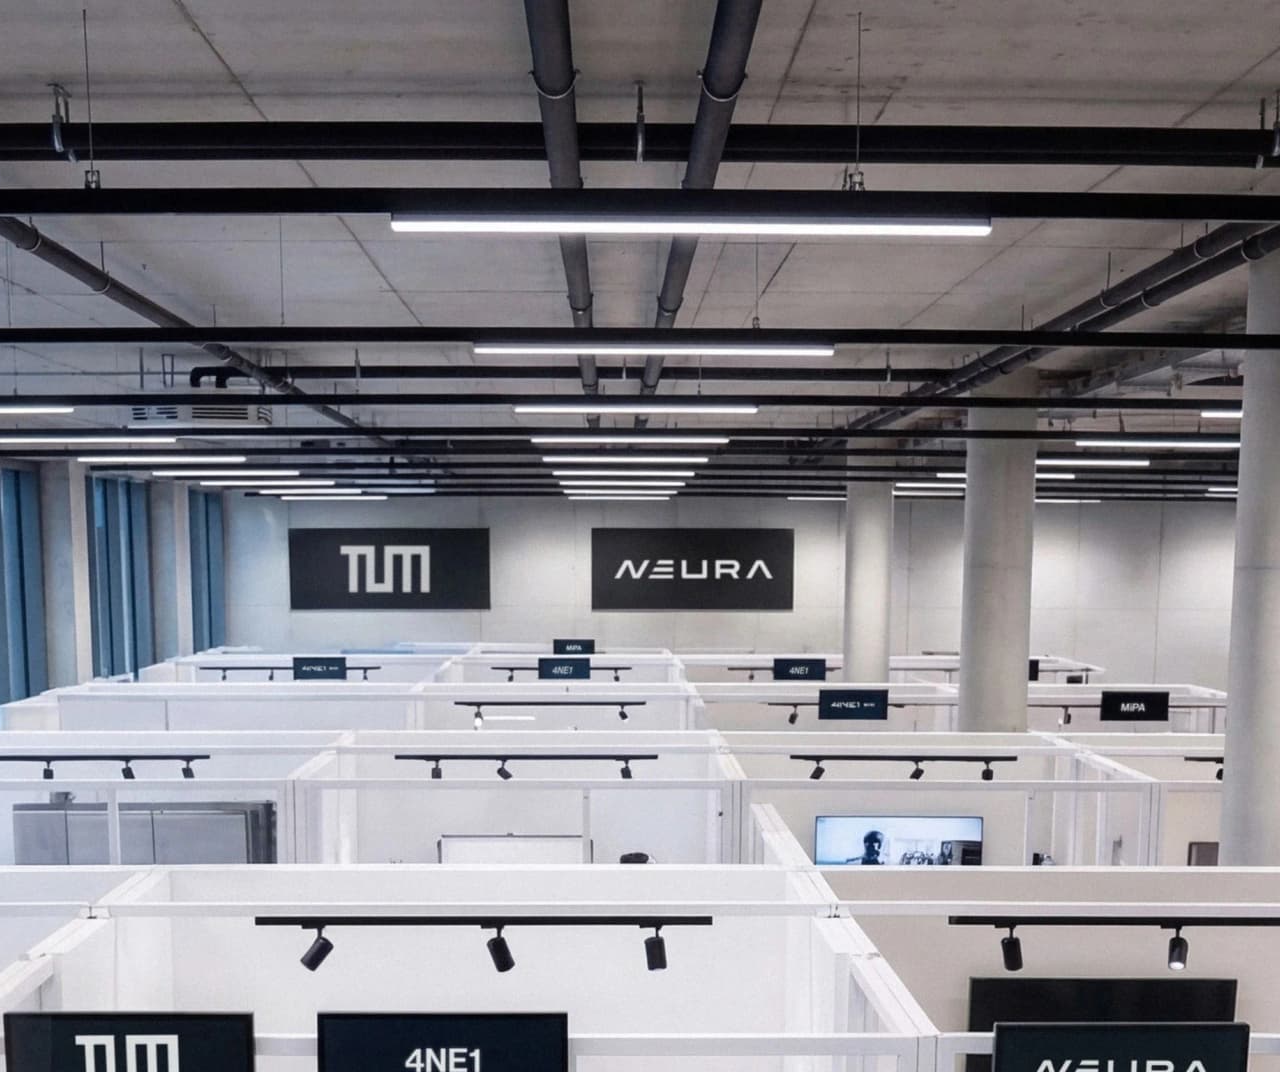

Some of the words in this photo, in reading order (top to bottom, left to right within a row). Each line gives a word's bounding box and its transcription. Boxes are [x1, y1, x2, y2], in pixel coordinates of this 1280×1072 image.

[339, 545, 431, 593] TUM
[614, 559, 773, 579] NEURA
[1120, 702, 1146, 712] MiPA
[404, 1047, 481, 1072] 4NE1
